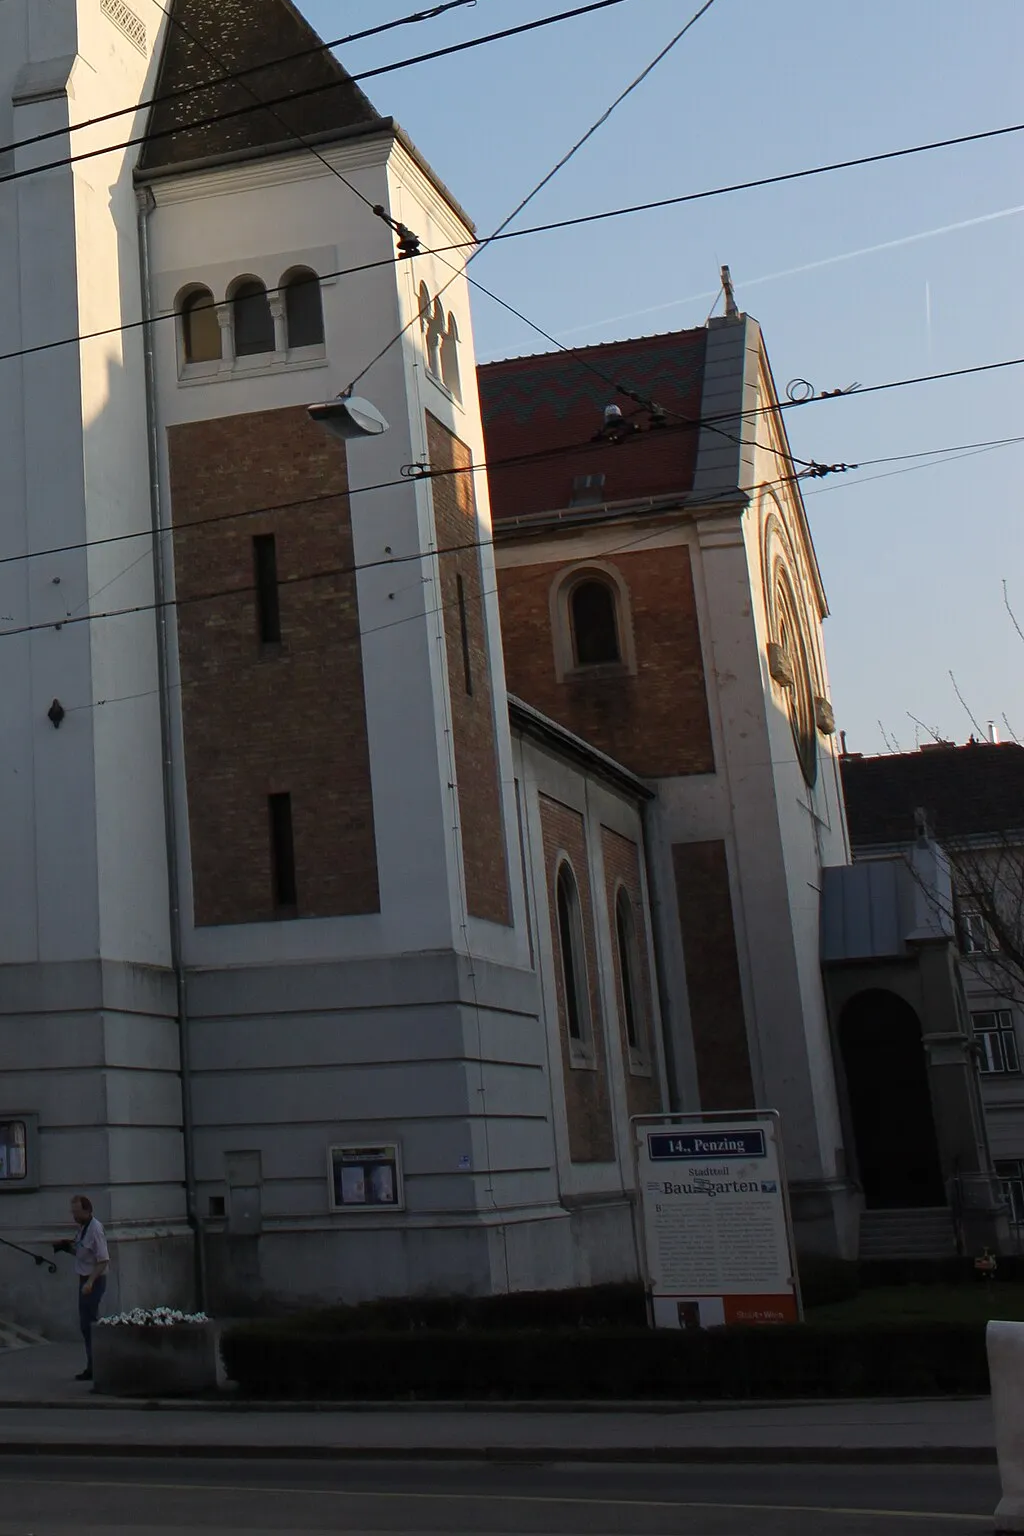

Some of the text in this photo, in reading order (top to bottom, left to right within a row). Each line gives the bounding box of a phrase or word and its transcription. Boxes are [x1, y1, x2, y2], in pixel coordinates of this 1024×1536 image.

[694, 1138, 746, 1153] Penzing
[688, 1166, 730, 1177] Stadtteil
[663, 1180, 759, 1197] Baugarten
